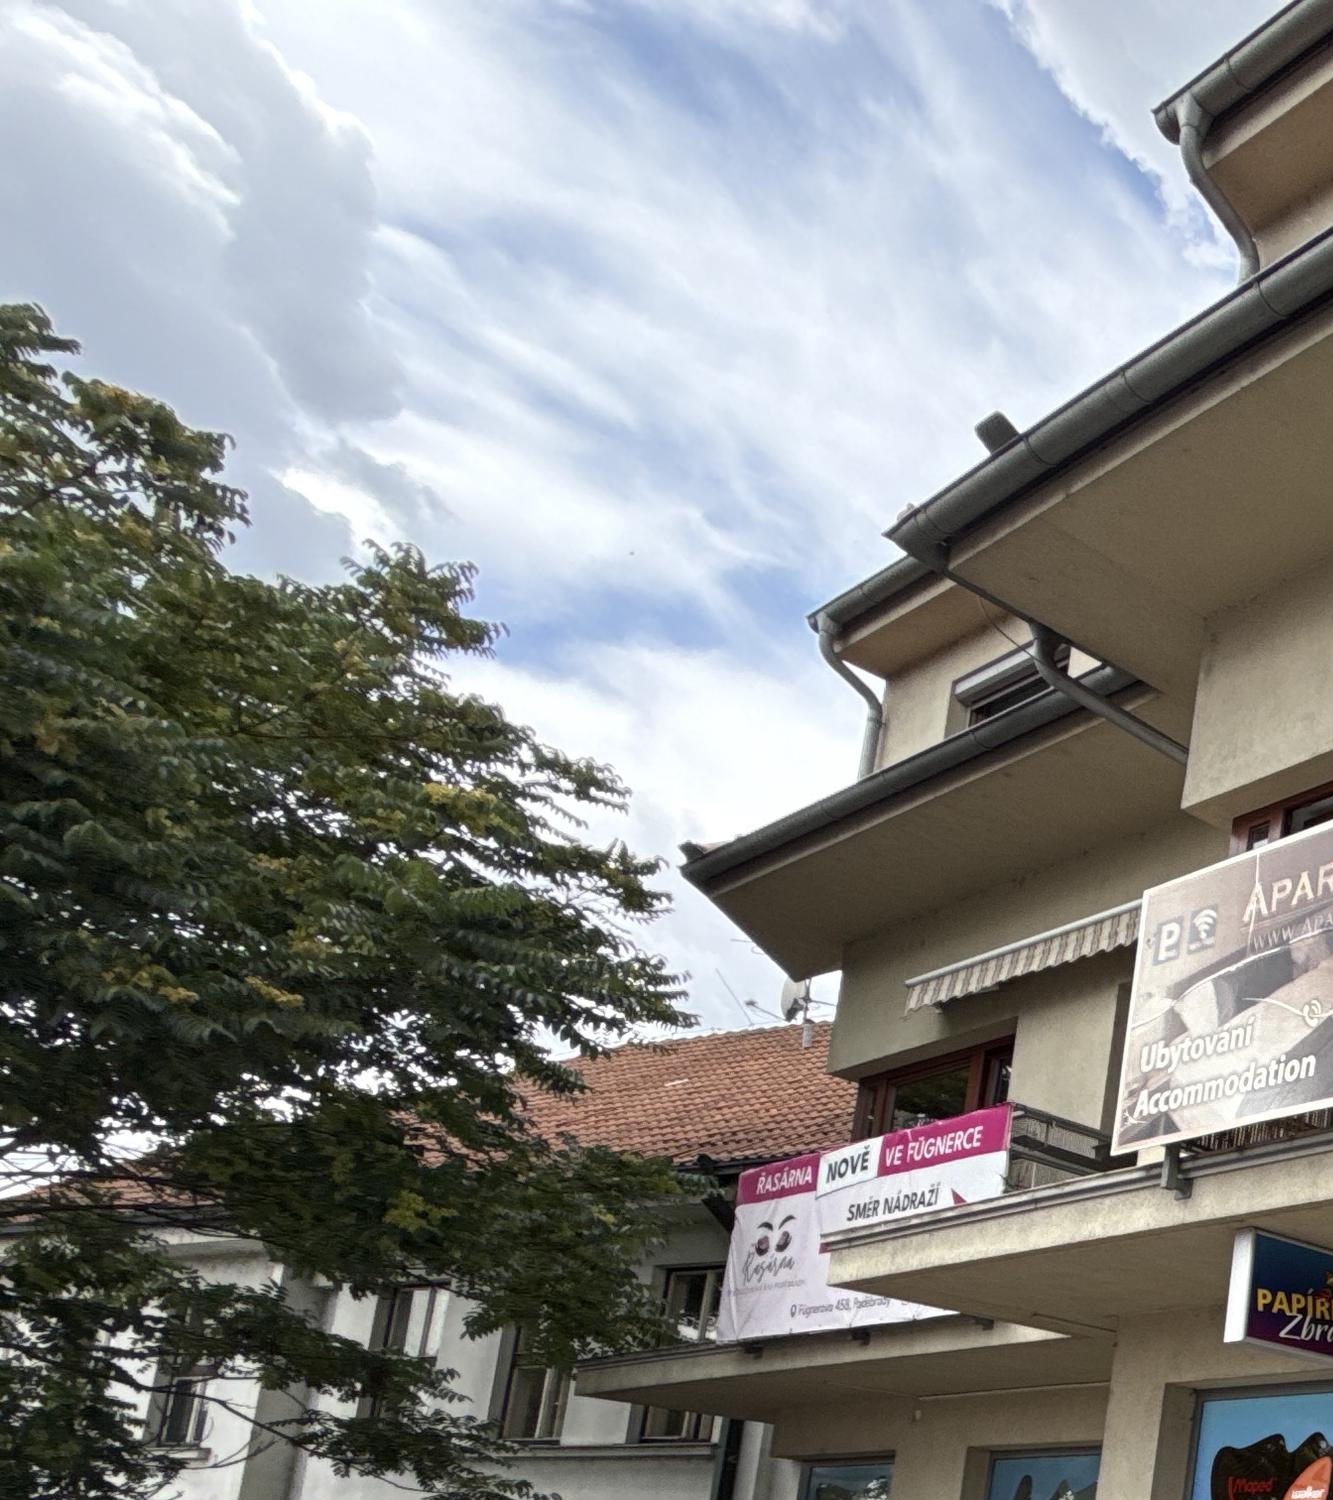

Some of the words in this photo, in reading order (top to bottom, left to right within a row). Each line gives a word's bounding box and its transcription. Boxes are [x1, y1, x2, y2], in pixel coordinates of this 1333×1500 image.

[1139, 1016, 1256, 1074] Ubytování
[1132, 1053, 1317, 1117] Accommodation
[756, 1165, 813, 1195] ŘASÁRNA
[826, 1144, 870, 1183] NOVĚ
[885, 1144, 903, 1168] VE
[846, 1193, 879, 1222] SMĚR
[883, 1182, 941, 1215] NÁDRAŽÍ
